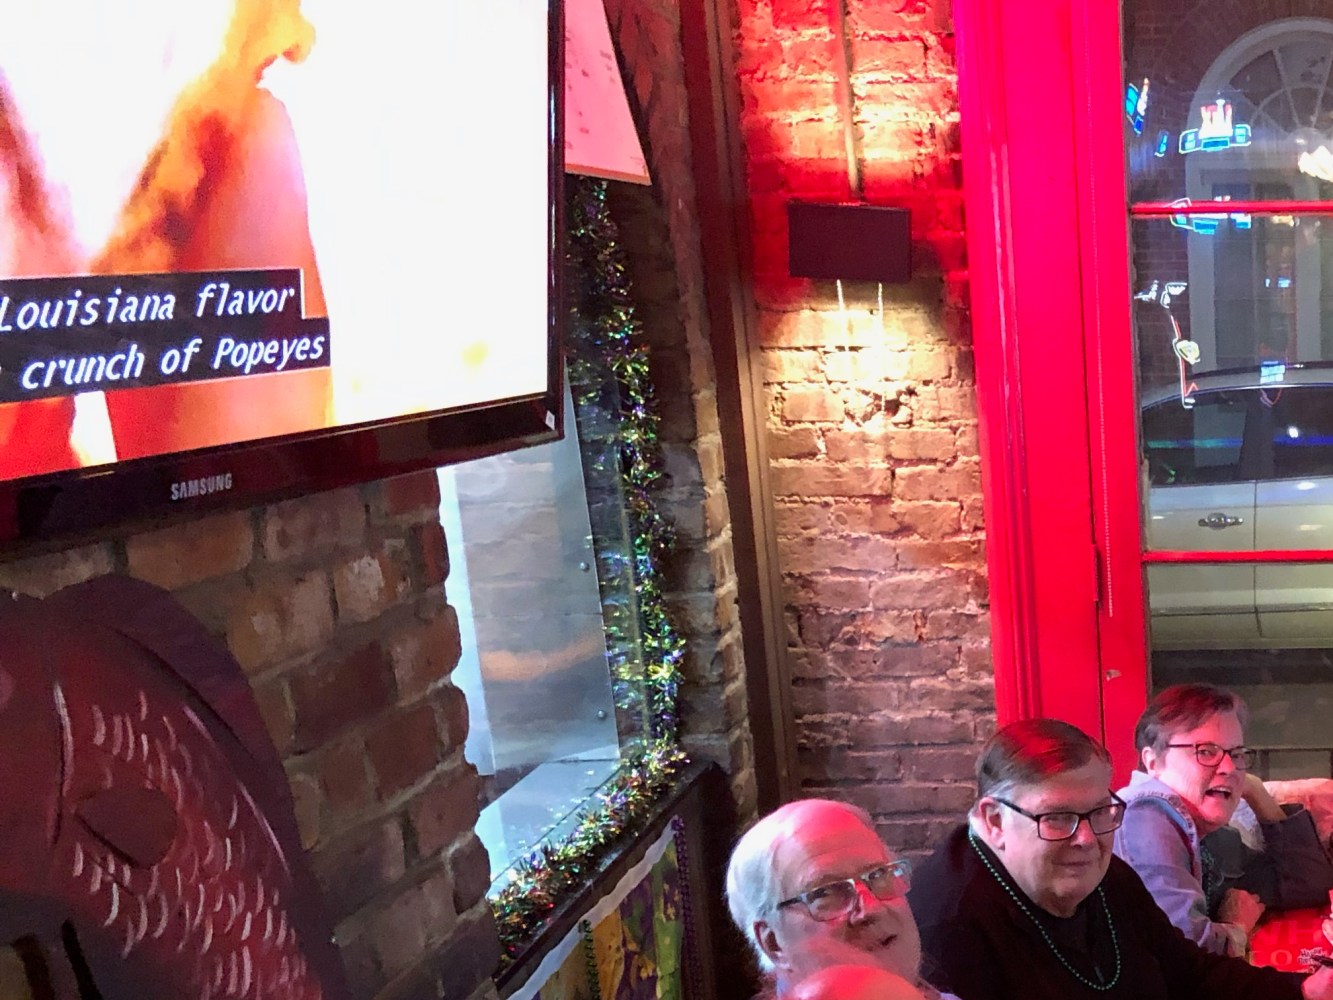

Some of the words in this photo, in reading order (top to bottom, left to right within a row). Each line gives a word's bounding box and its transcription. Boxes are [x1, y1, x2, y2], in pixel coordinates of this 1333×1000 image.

[0, 287, 177, 332] Louisiana
[195, 282, 296, 318] flavor
[22, 343, 146, 390] crunch
[160, 337, 203, 375] of
[213, 334, 325, 374] Popeyes
[170, 472, 233, 501] SAMSUNG
